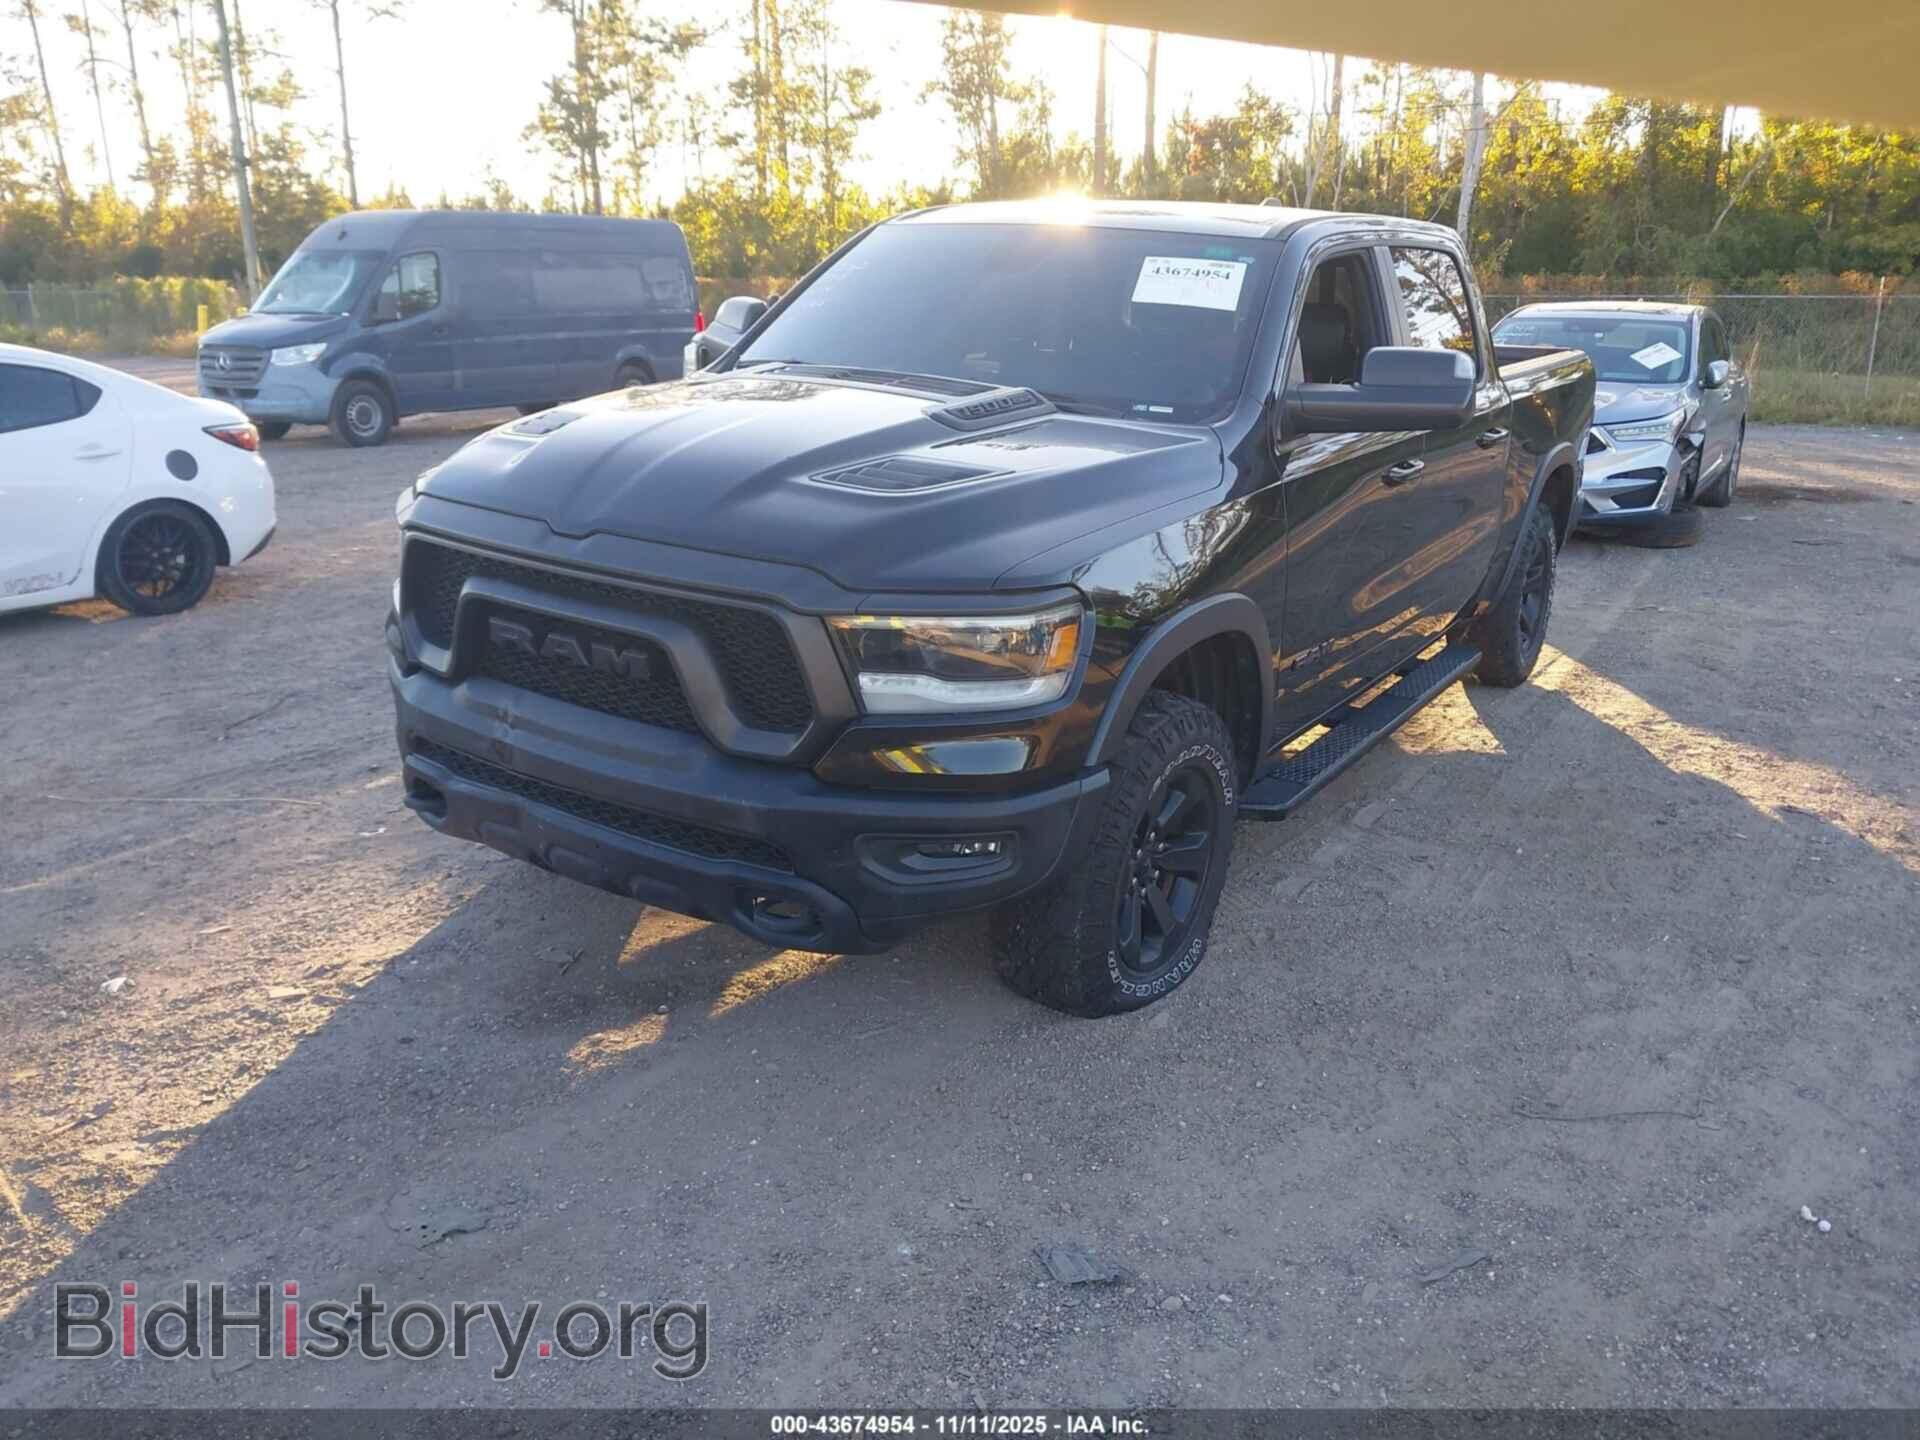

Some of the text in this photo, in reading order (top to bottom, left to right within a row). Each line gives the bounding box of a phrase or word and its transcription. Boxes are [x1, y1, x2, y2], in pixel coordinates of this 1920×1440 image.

[1152, 265, 1232, 281] 43674954
[488, 616, 649, 681] RAM
[1107, 937, 1203, 998] WRANGLER
